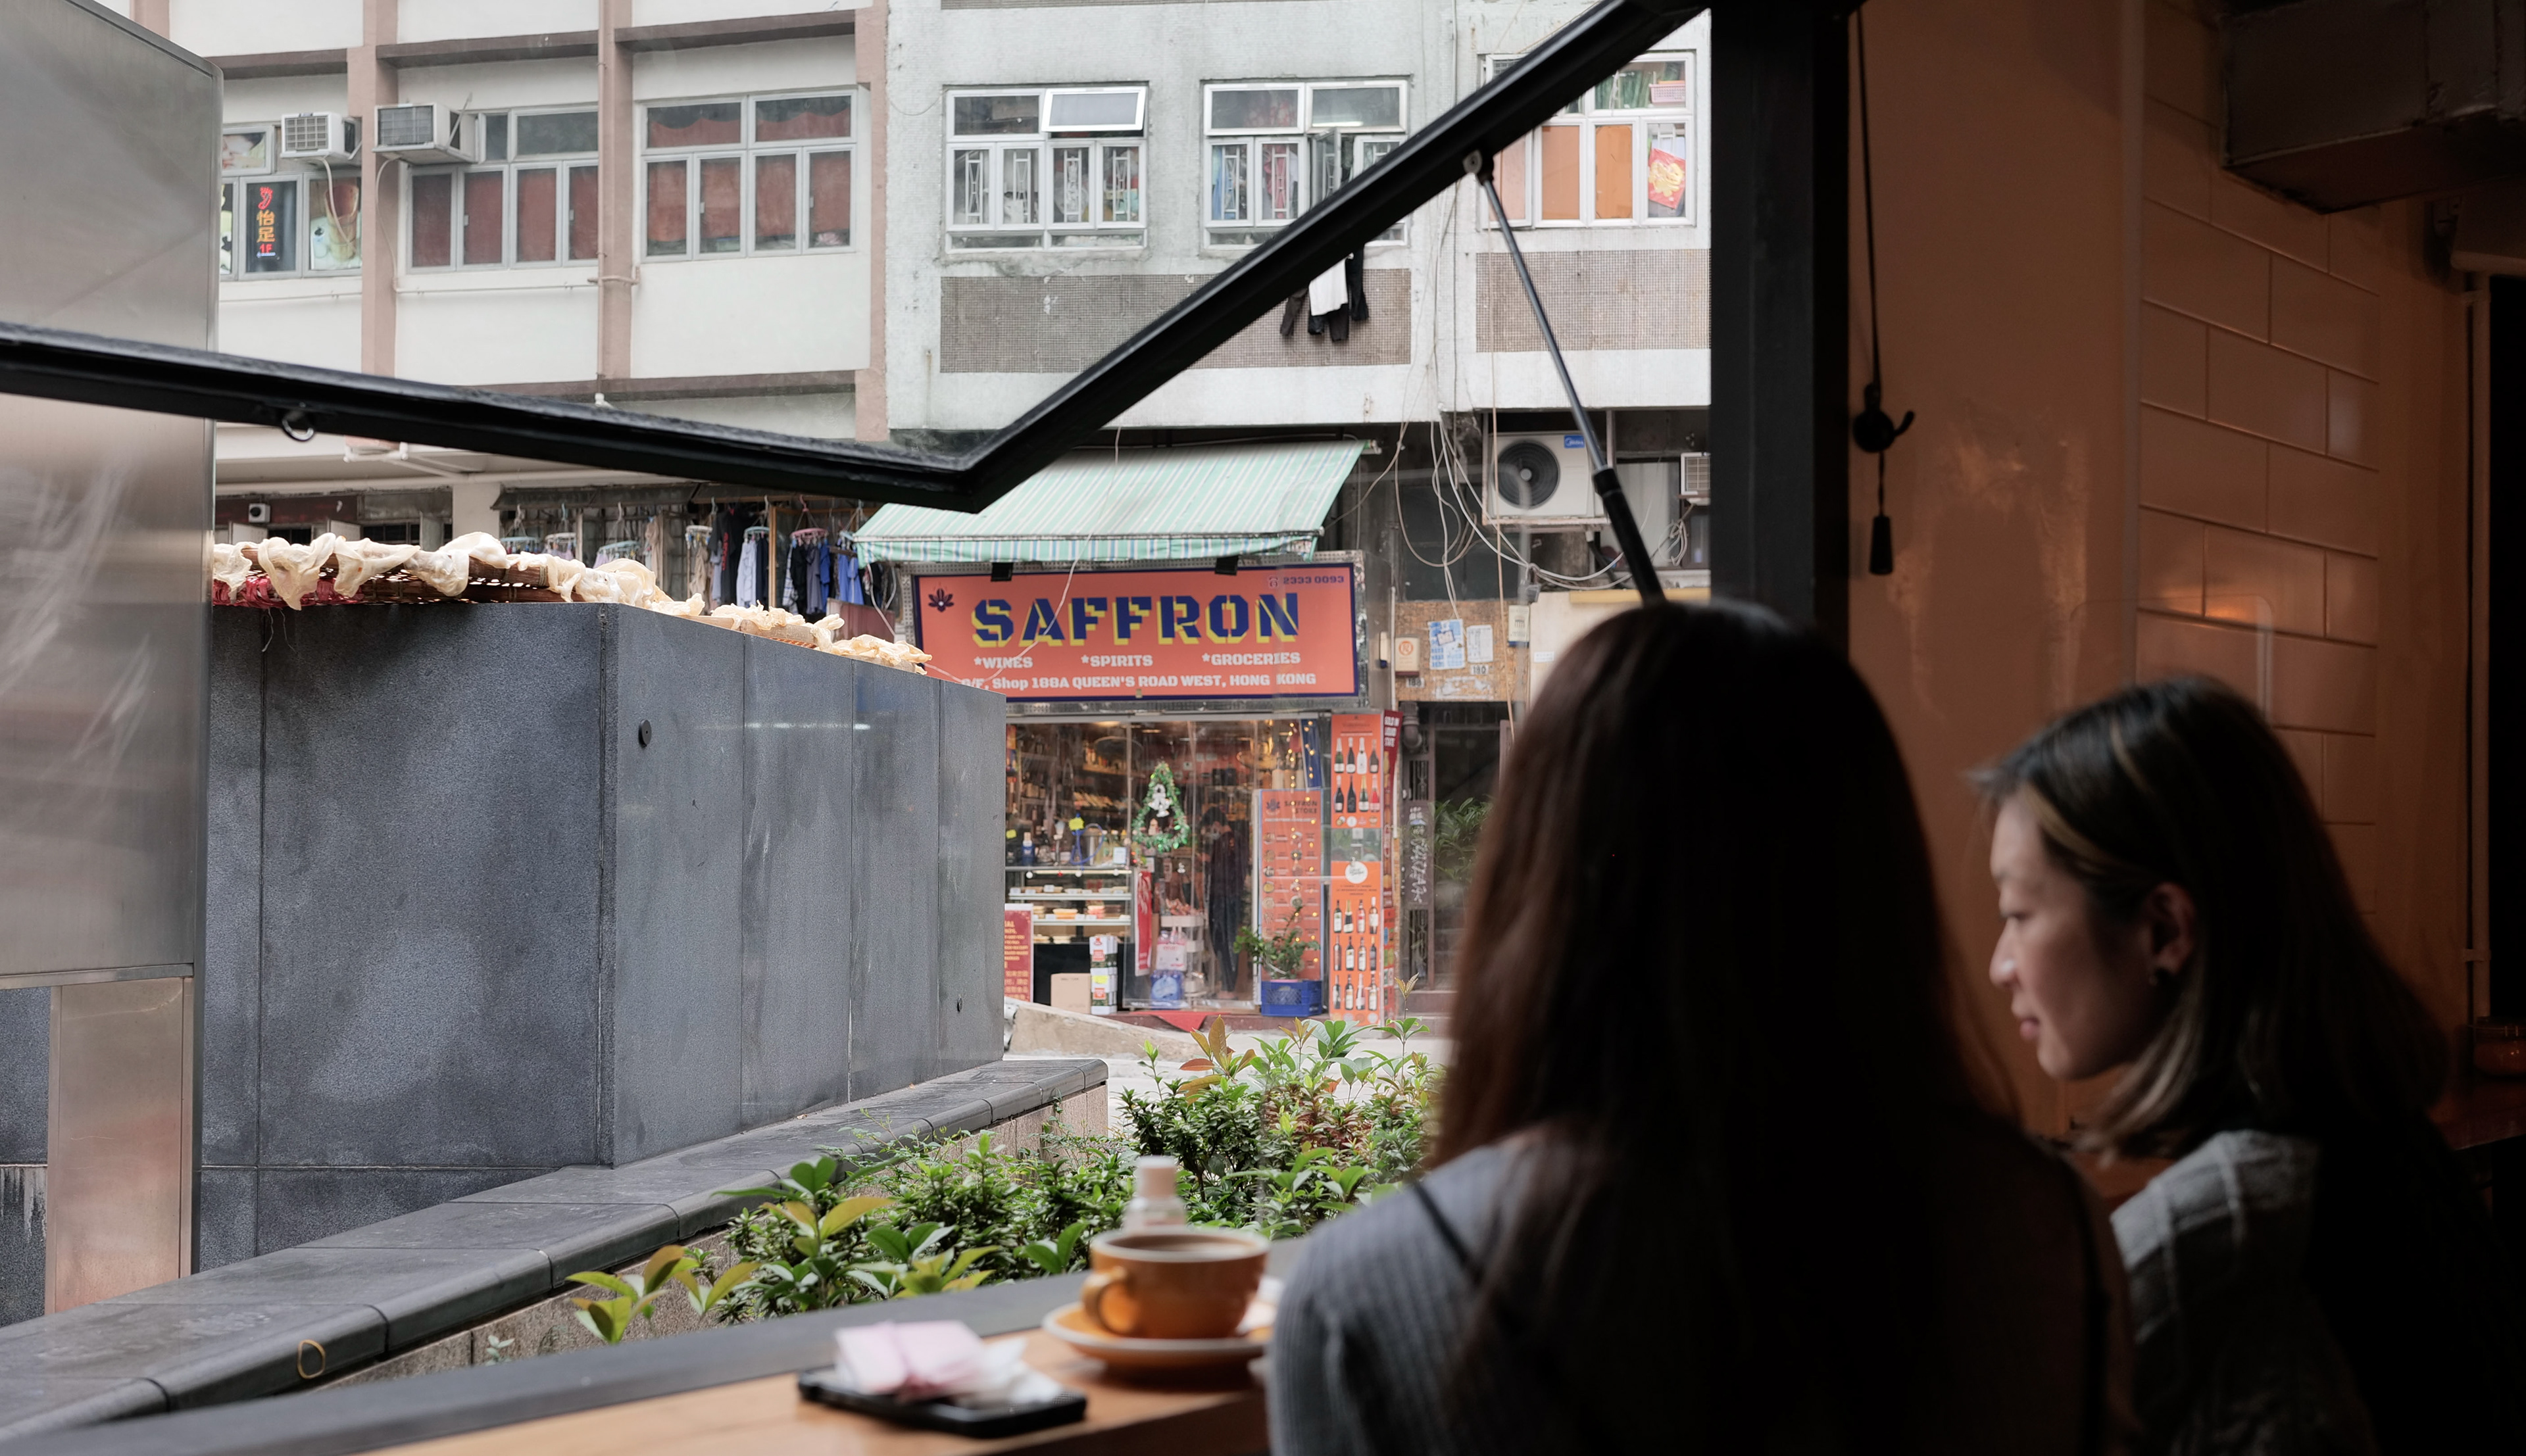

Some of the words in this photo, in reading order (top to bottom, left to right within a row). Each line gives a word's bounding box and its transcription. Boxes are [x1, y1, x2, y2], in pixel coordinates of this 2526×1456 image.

[257, 210, 276, 243] 怡足
[259, 243, 273, 253] 1F
[1314, 575, 1344, 584] 0093
[972, 593, 1299, 647] SAFFRON
[993, 677, 1029, 691] Shop
[1032, 677, 1070, 688] 188A
[1072, 676, 1135, 689] QUEEN'S
[1138, 675, 1178, 687] ROAD
[1181, 675, 1227, 688] WEST,
[1229, 674, 1271, 687] HONG
[1276, 673, 1317, 685] KONG
